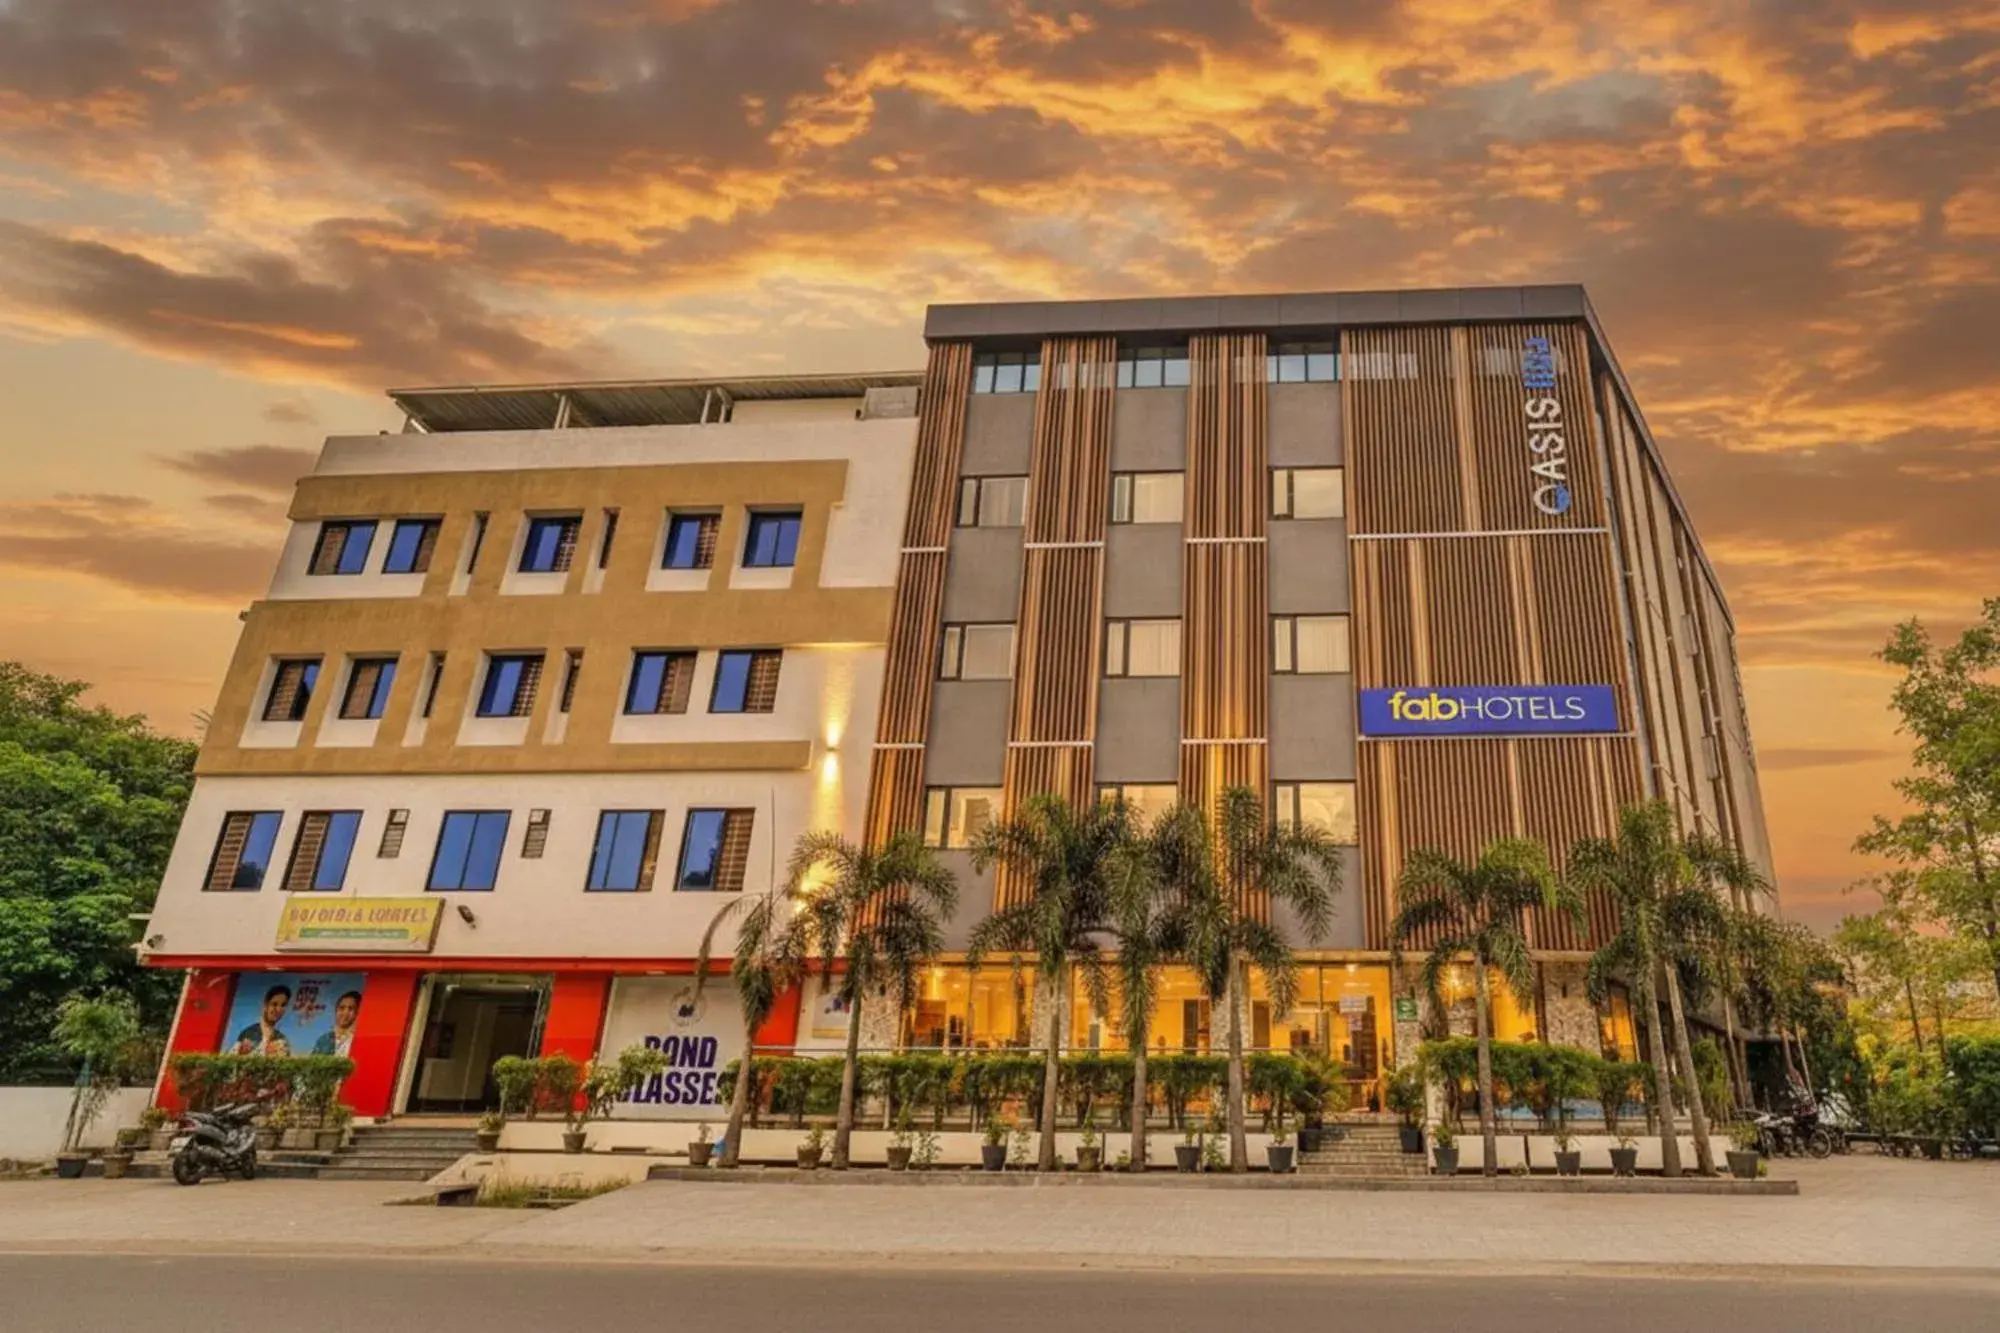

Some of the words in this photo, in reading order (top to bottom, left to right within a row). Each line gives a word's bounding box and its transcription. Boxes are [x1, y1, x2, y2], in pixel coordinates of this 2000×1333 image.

[1525, 398, 1572, 515] OASIS
[1388, 691, 1586, 720] fabHOTELS
[617, 1072, 734, 1105] LASSE
